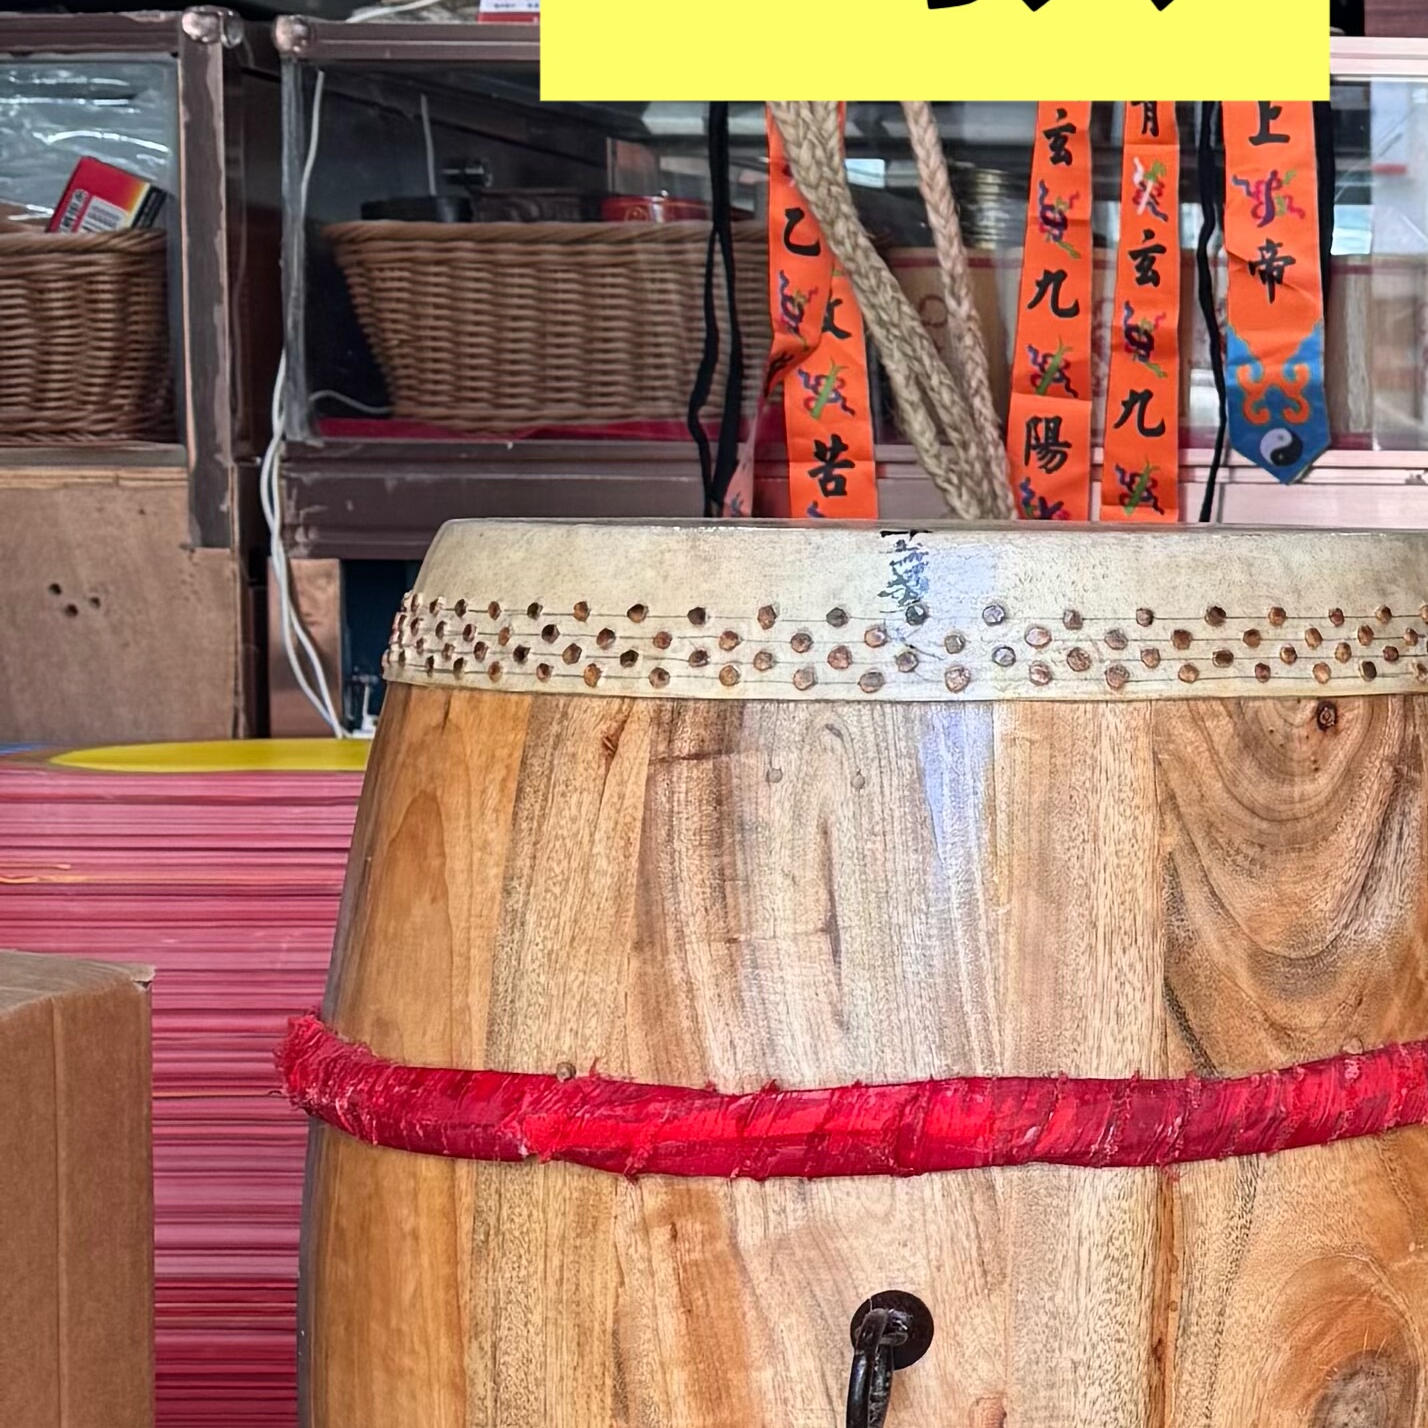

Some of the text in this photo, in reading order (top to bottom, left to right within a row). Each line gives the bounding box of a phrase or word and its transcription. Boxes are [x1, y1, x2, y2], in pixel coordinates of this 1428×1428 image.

[1025, 108, 1080, 474] 玄九陽
[1248, 102, 1296, 304] 上帝
